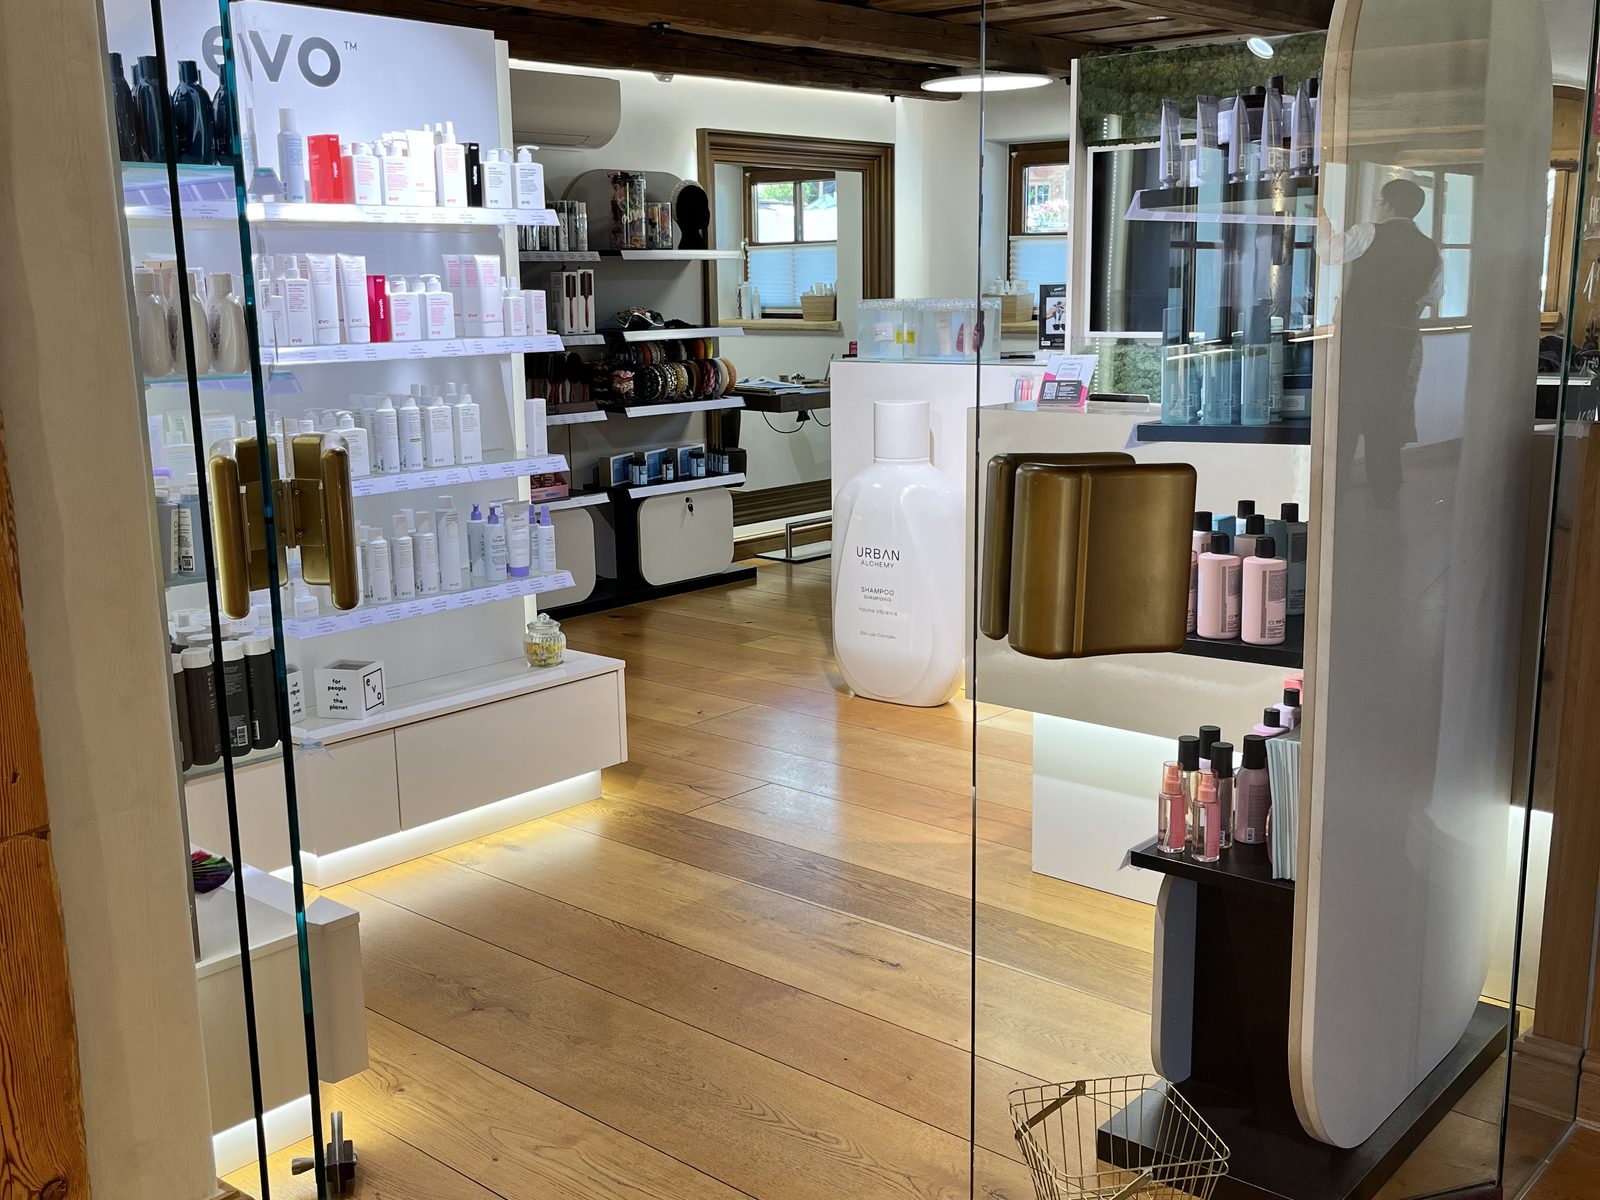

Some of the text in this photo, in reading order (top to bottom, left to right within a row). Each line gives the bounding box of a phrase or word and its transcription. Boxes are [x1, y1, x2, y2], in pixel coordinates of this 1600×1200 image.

[201, 25, 341, 88] evo
[856, 546, 900, 561] URBAN
[860, 560, 895, 569] ALCHEMY
[860, 586, 895, 596] SHAMPOO
